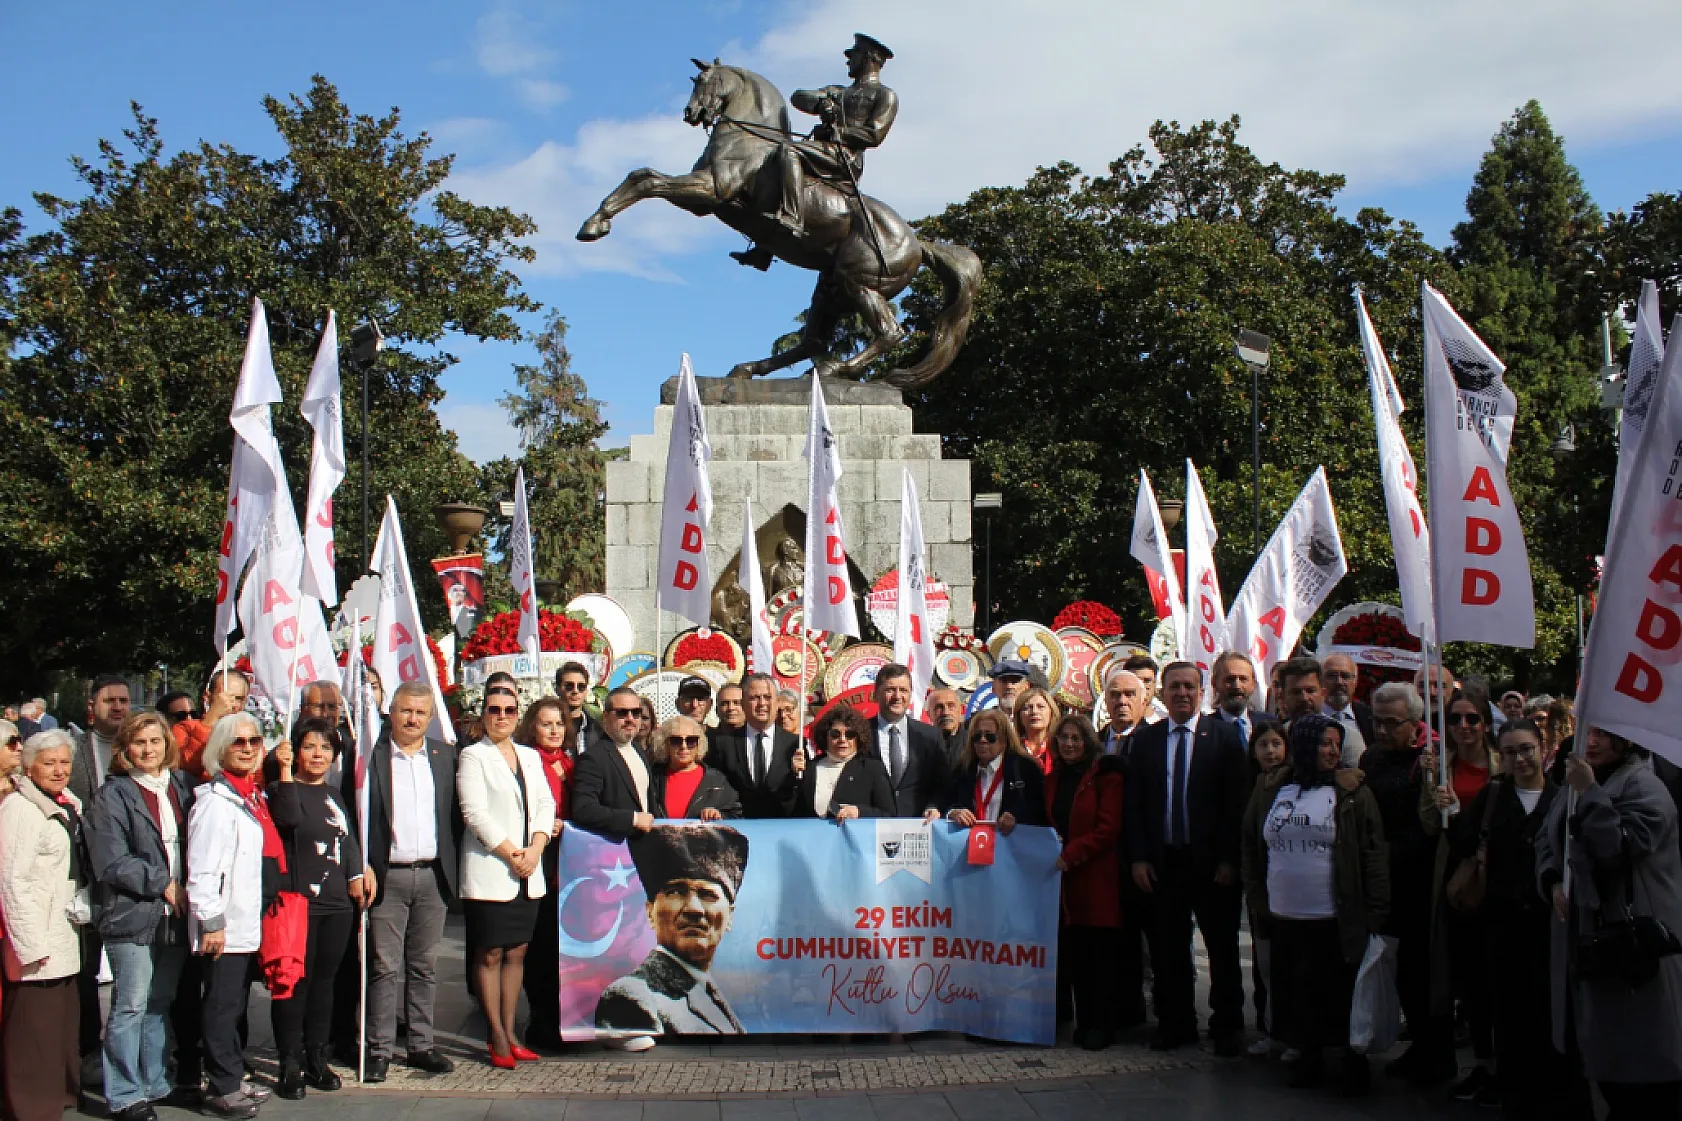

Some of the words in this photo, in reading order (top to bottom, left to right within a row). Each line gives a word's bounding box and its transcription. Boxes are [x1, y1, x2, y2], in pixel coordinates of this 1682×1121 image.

[1461, 465, 1502, 605] ADD
[855, 907, 885, 929] 29
[891, 900, 953, 929] EKİM
[756, 932, 926, 960] CUMHURİYET
[932, 937, 1047, 969] BAYRAMI
[821, 963, 899, 1016] Kutlu
[905, 962, 981, 1015] Olsun
